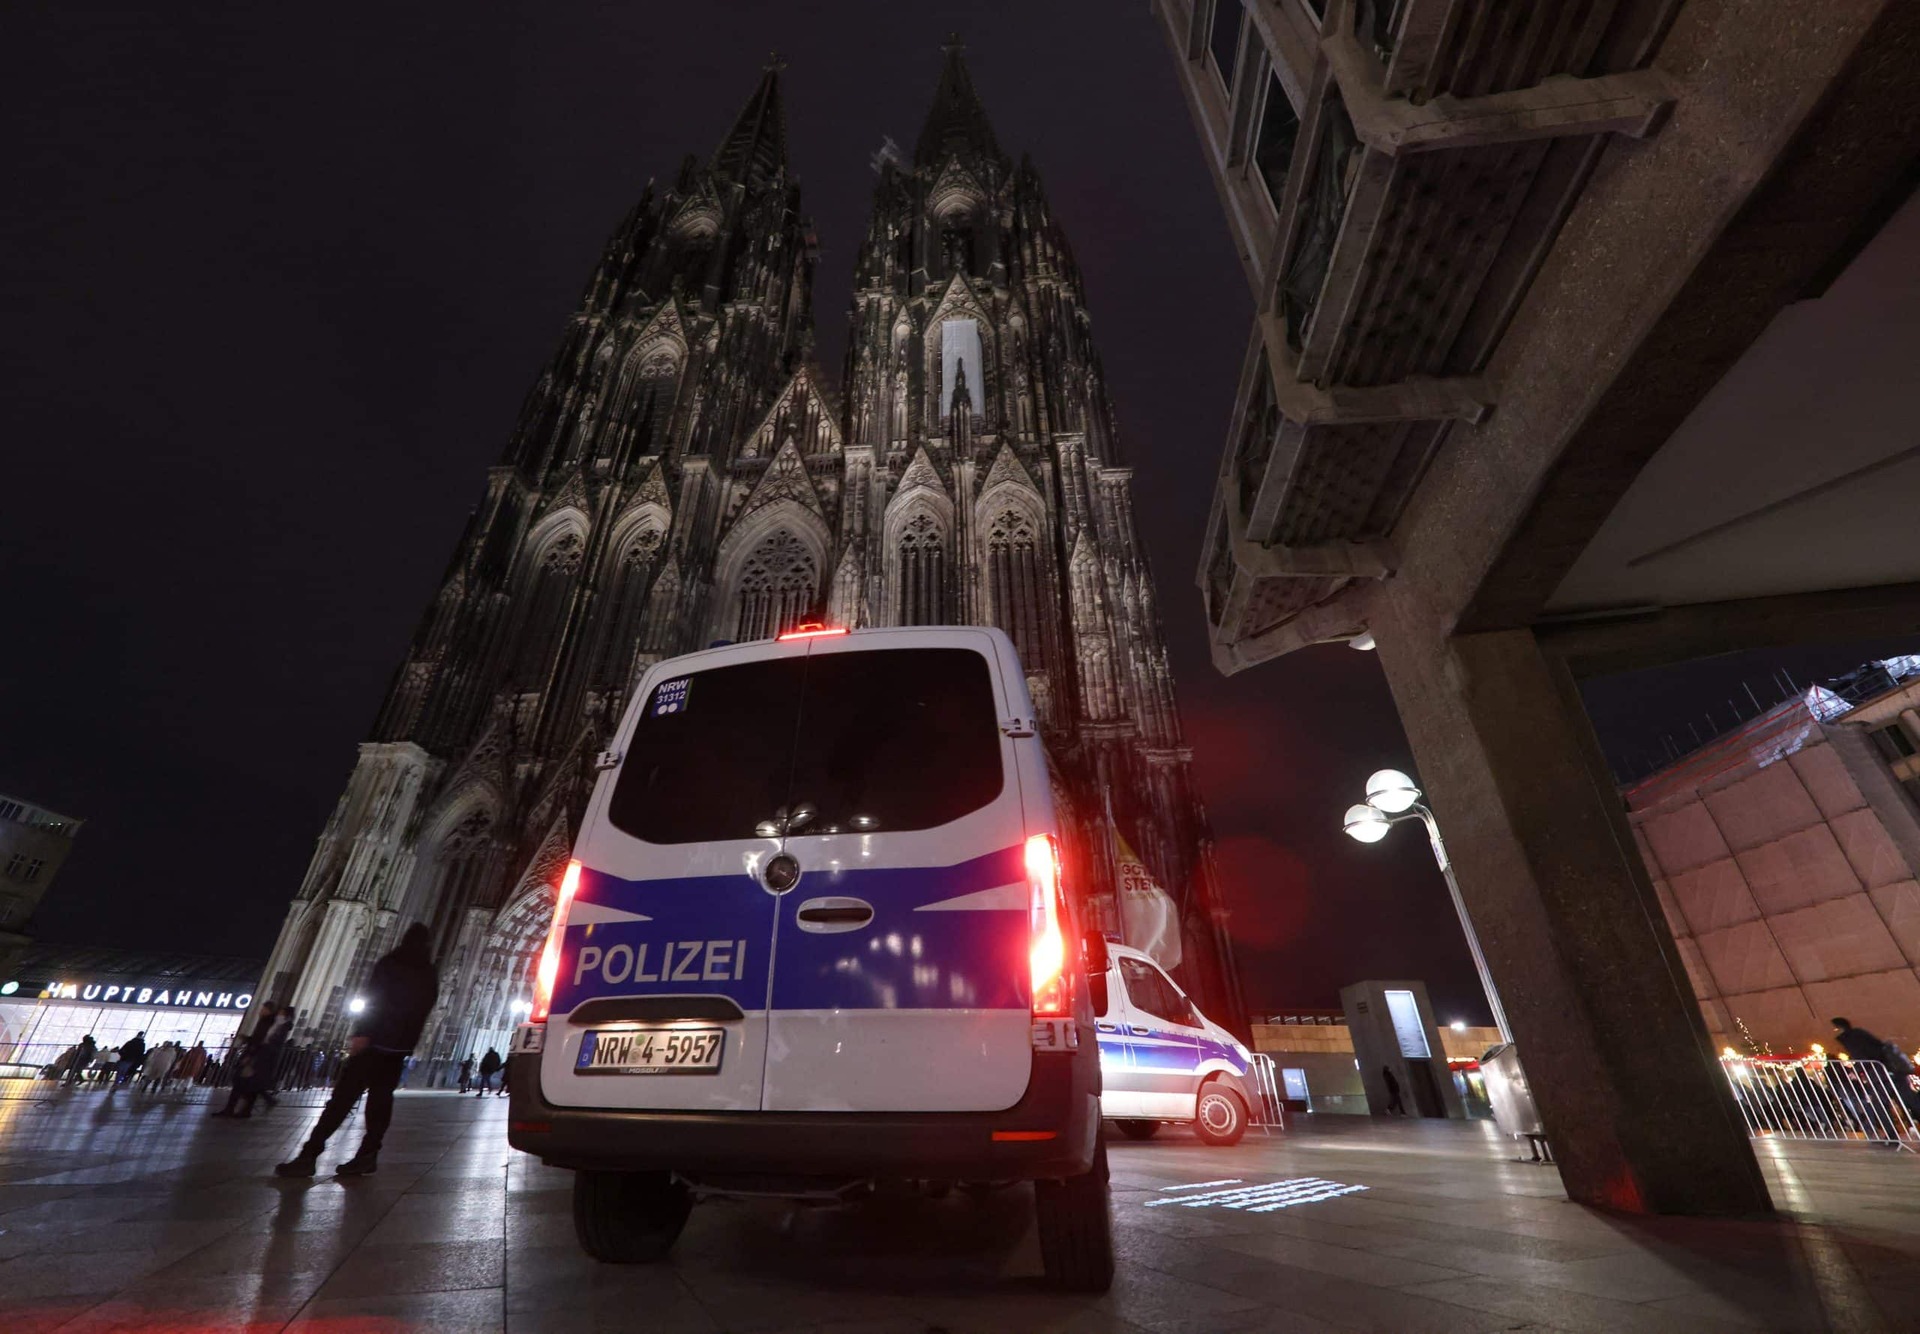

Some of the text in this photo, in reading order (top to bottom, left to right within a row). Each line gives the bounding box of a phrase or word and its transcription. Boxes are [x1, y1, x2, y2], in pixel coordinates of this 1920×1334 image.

[656, 691, 686, 703] 31312
[659, 679, 689, 694] NRW
[573, 940, 747, 986] POLIZEI
[47, 982, 252, 1008] HAUPTBAHNHO
[591, 1035, 721, 1064] NRW 4-5957
